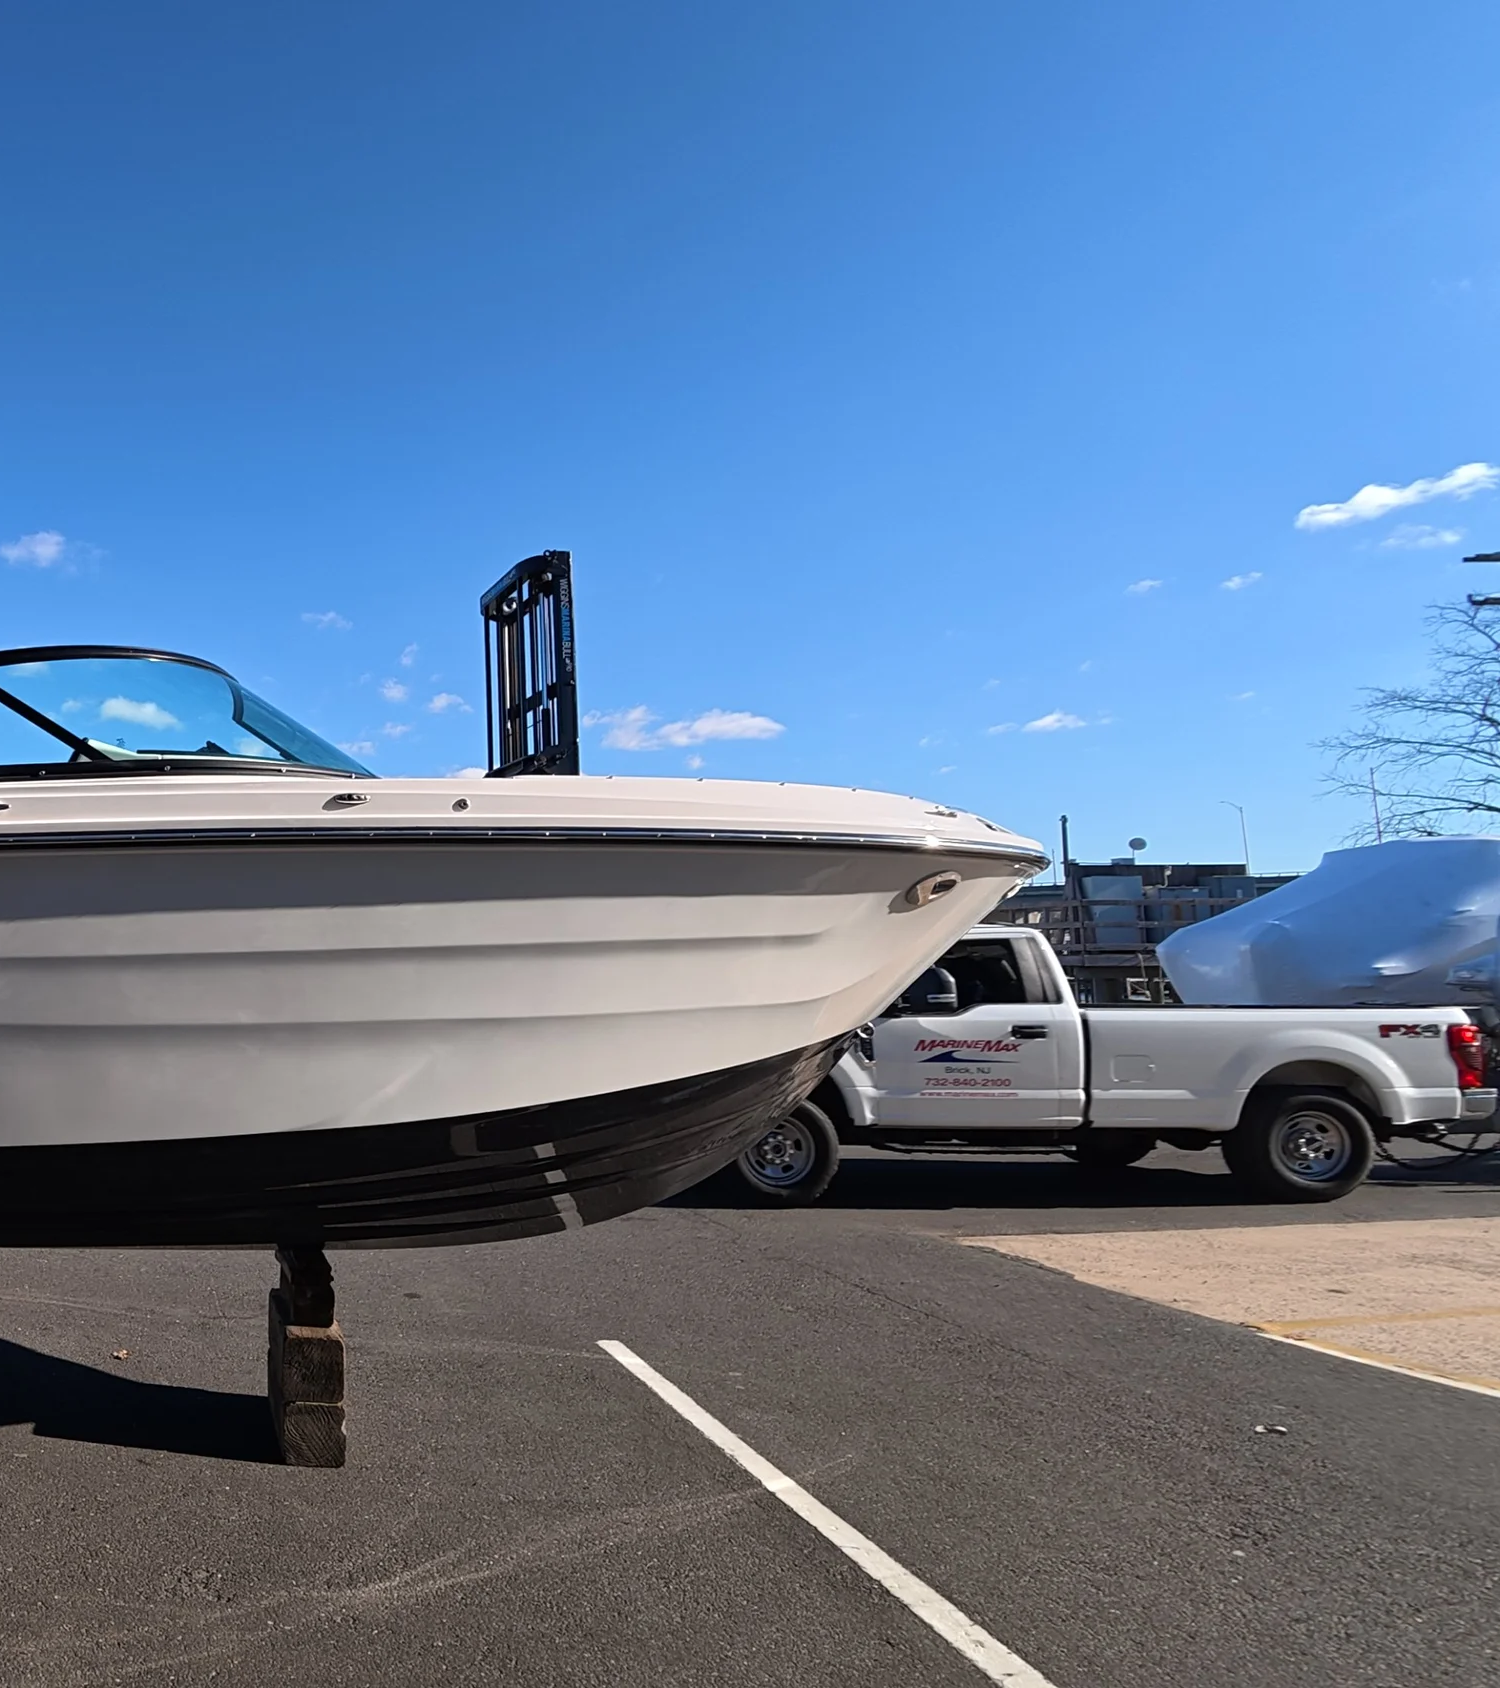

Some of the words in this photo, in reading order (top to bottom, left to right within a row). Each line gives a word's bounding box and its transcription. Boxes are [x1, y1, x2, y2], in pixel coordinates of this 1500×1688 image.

[1378, 1024, 1441, 1038] FX4
[945, 1066, 974, 1075] Brick,
[924, 1077, 1012, 1088] 732-840-2100
